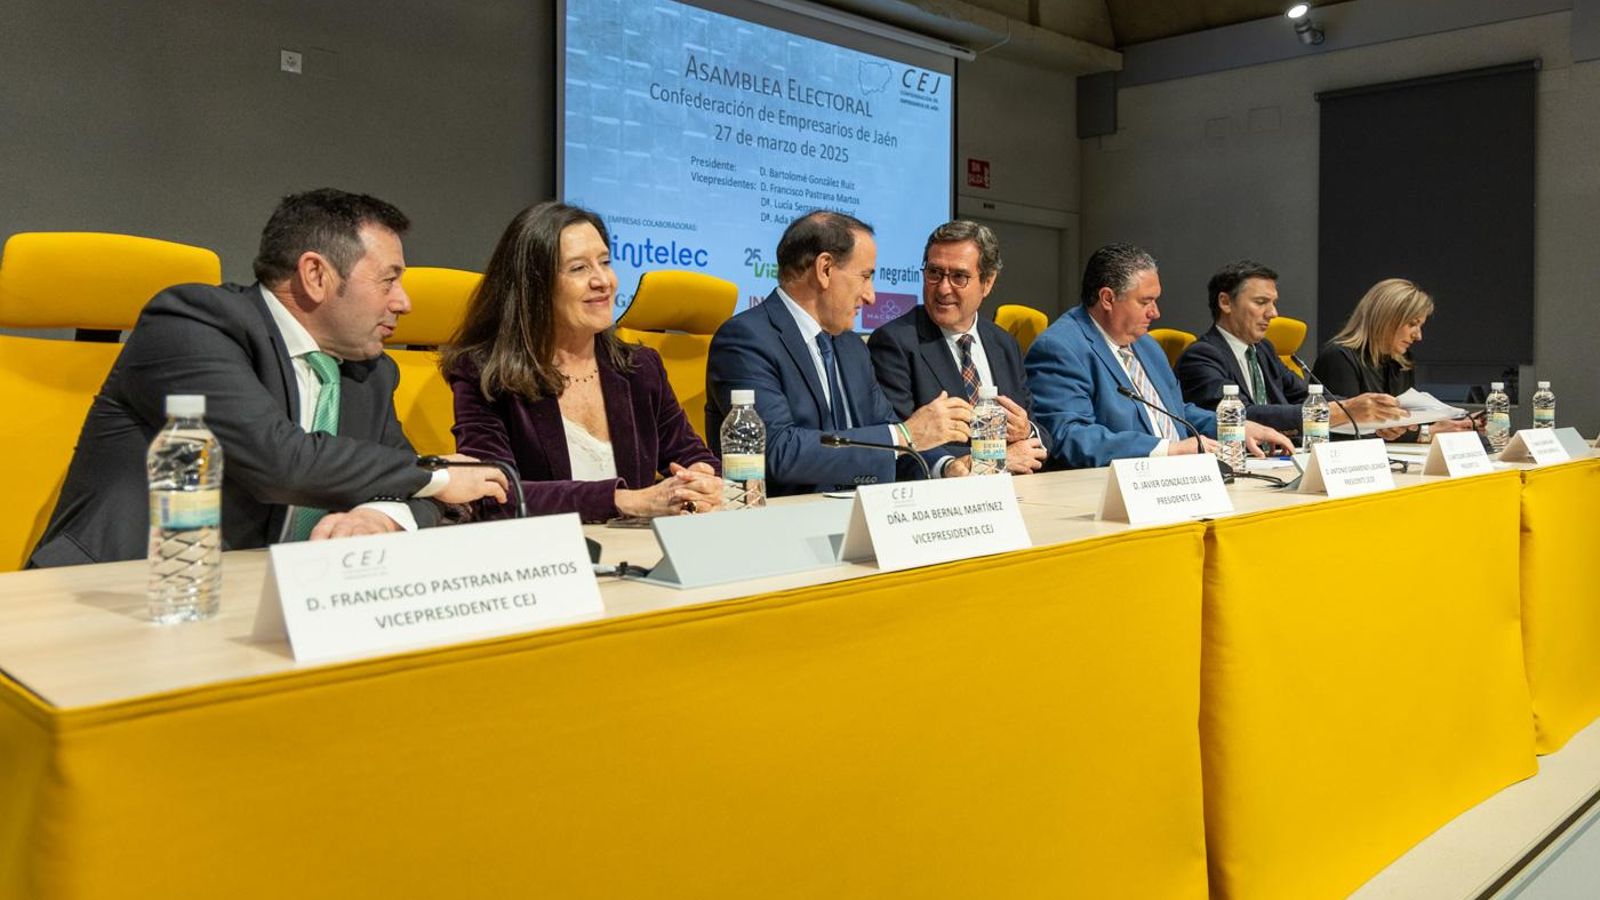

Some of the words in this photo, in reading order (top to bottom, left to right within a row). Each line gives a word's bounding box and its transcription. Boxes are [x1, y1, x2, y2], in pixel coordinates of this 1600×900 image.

[685, 54, 783, 98] ASAMBLEA
[788, 78, 873, 118] ELECTORAL
[902, 68, 941, 94] CEJ
[649, 82, 754, 119] Confederación
[758, 105, 775, 123] de
[778, 109, 854, 139] Empresarios
[856, 125, 870, 142] de
[872, 129, 898, 148] Jaén
[714, 124, 732, 142] 27
[736, 129, 753, 146] de
[757, 135, 797, 154] marzo
[801, 140, 816, 157] de
[820, 143, 849, 163] 2025
[690, 155, 737, 172] Presidente:
[690, 172, 757, 191] Vicepresidentes:
[769, 168, 808, 183] Bartolomé
[809, 174, 839, 188] González
[841, 180, 855, 190] Ruiz
[770, 183, 804, 197] Francisco
[805, 188, 835, 202] Pastrana
[836, 193, 860, 205] Martos
[607, 215, 641, 226] EMPRESAS
[880, 265, 920, 286] negratín
[891, 487, 915, 500] CEJ
[1141, 479, 1161, 490] JAVIER
[1157, 495, 1190, 505] PRESIDENTE
[887, 510, 910, 526] DÑA.
[912, 508, 931, 522] ADA
[932, 506, 963, 520] BERNAL
[964, 500, 1004, 516] MARTÍNEZ
[913, 526, 980, 544] VICEPRESIDENTA
[981, 524, 994, 535] CEJ
[341, 548, 387, 570] CEJ
[306, 598, 327, 612] D.
[331, 582, 426, 608] FRANCISCO
[431, 572, 513, 595] PASTRANA
[516, 561, 578, 582] MARTOS
[375, 598, 509, 630] VICEPRESIDENTE
[513, 593, 537, 612] CEJ
